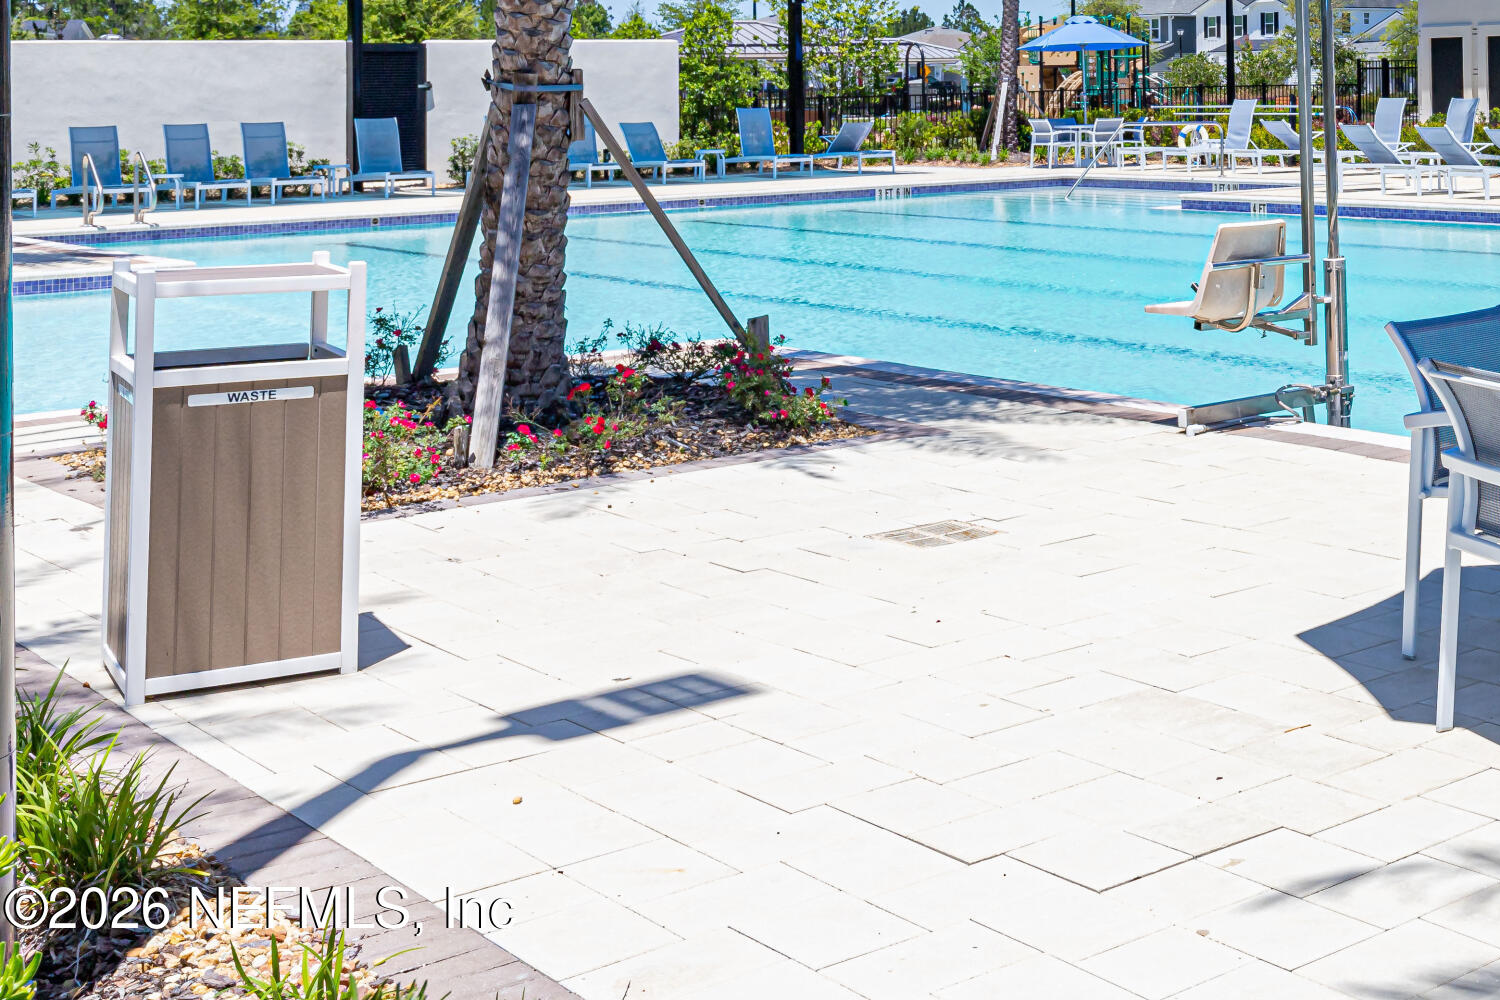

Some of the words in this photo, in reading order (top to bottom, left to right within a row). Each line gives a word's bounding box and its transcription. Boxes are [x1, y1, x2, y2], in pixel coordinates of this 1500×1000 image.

[1219, 184, 1226, 192] FT
[1258, 204, 1266, 213] FT
[227, 389, 277, 403] WASTE
